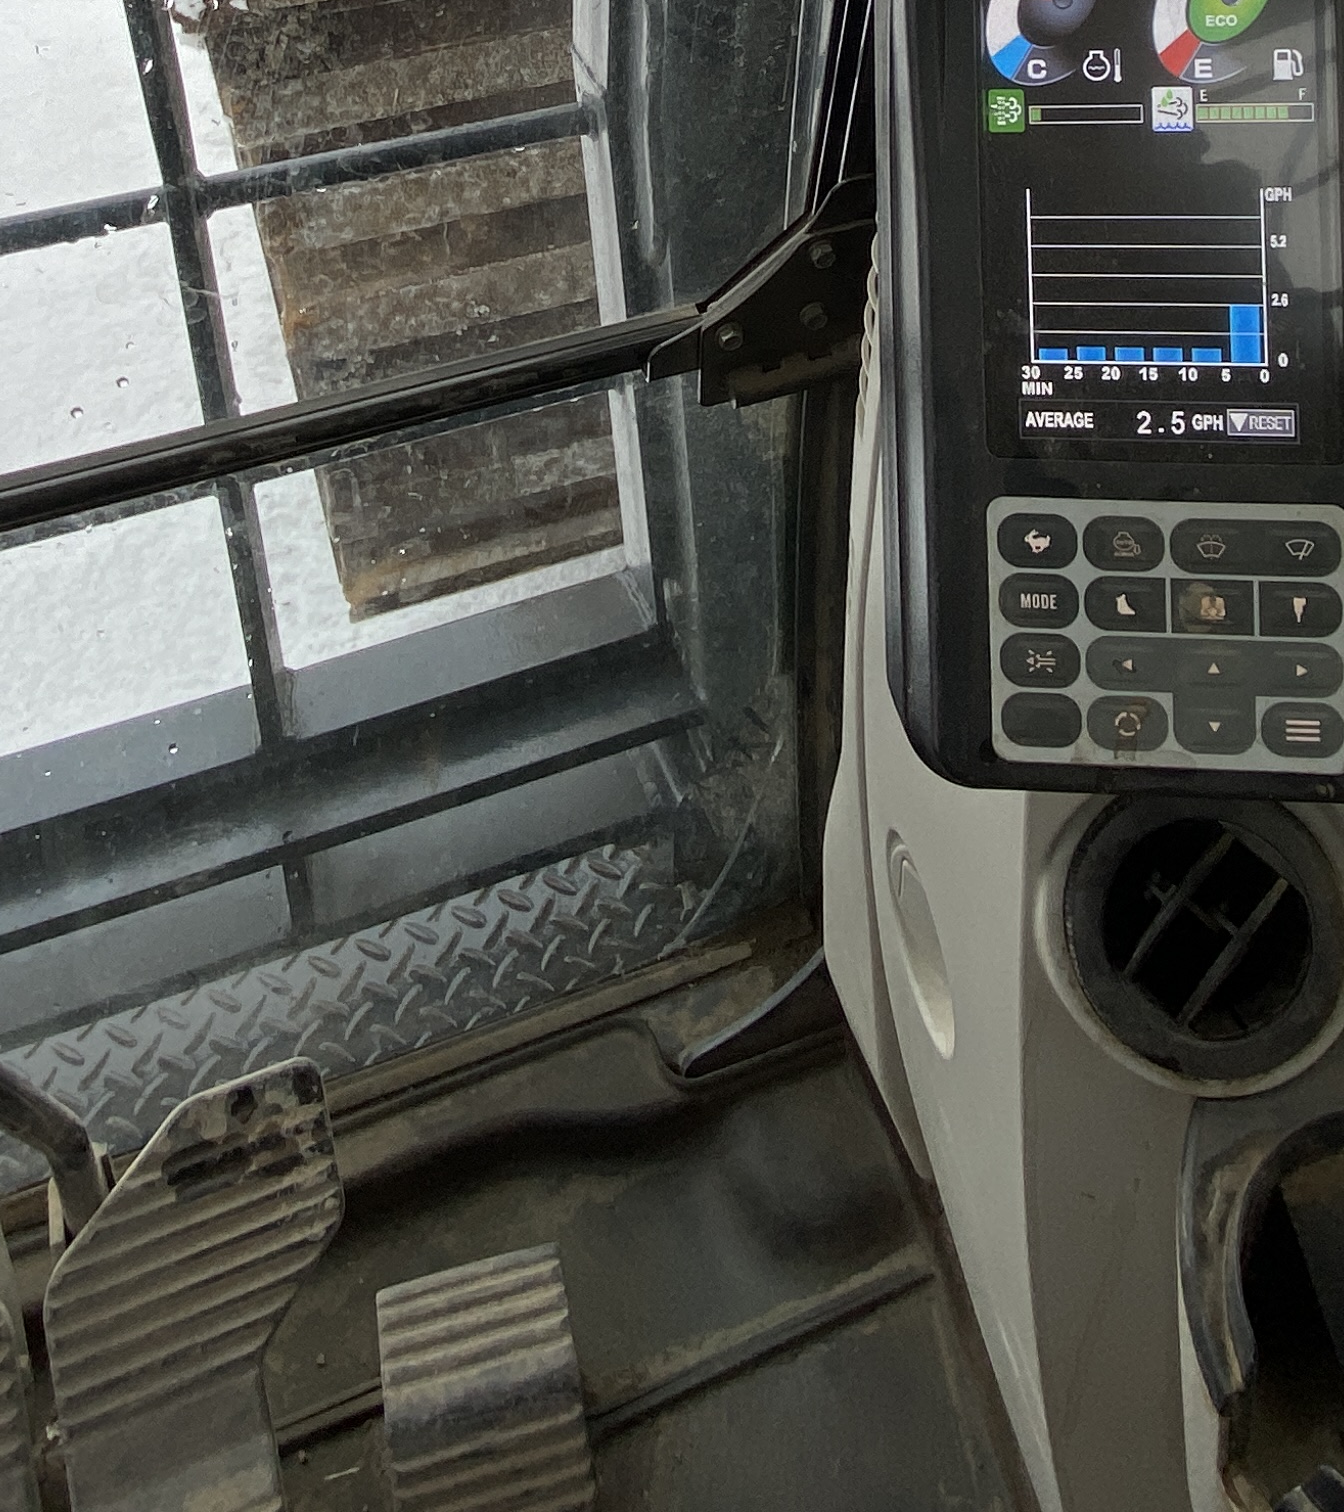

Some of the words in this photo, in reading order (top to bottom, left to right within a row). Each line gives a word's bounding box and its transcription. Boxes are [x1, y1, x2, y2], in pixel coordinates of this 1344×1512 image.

[1206, 14, 1237, 27] ECO
[1027, 59, 1047, 79] C
[1194, 59, 1212, 77] E
[1200, 89, 1207, 101] E
[1299, 89, 1306, 100] F
[1264, 187, 1292, 202] GPH
[1270, 235, 1286, 248] 5.2
[1271, 294, 1288, 307] 2.6
[1278, 353, 1288, 367] 0
[1022, 366, 1041, 380] 30
[1064, 367, 1083, 381] 25
[1102, 367, 1120, 381] 20
[1139, 367, 1158, 381] 15
[1179, 367, 1198, 381] 10
[1221, 368, 1231, 382] 5
[1260, 369, 1269, 383] 0
[1022, 382, 1053, 396] MIN
[1025, 412, 1094, 429] AVERAGE
[1136, 410, 1185, 434] 2.5
[1192, 415, 1223, 431] GPH
[1249, 416, 1291, 431] RESET
[1021, 594, 1057, 610] MODE
